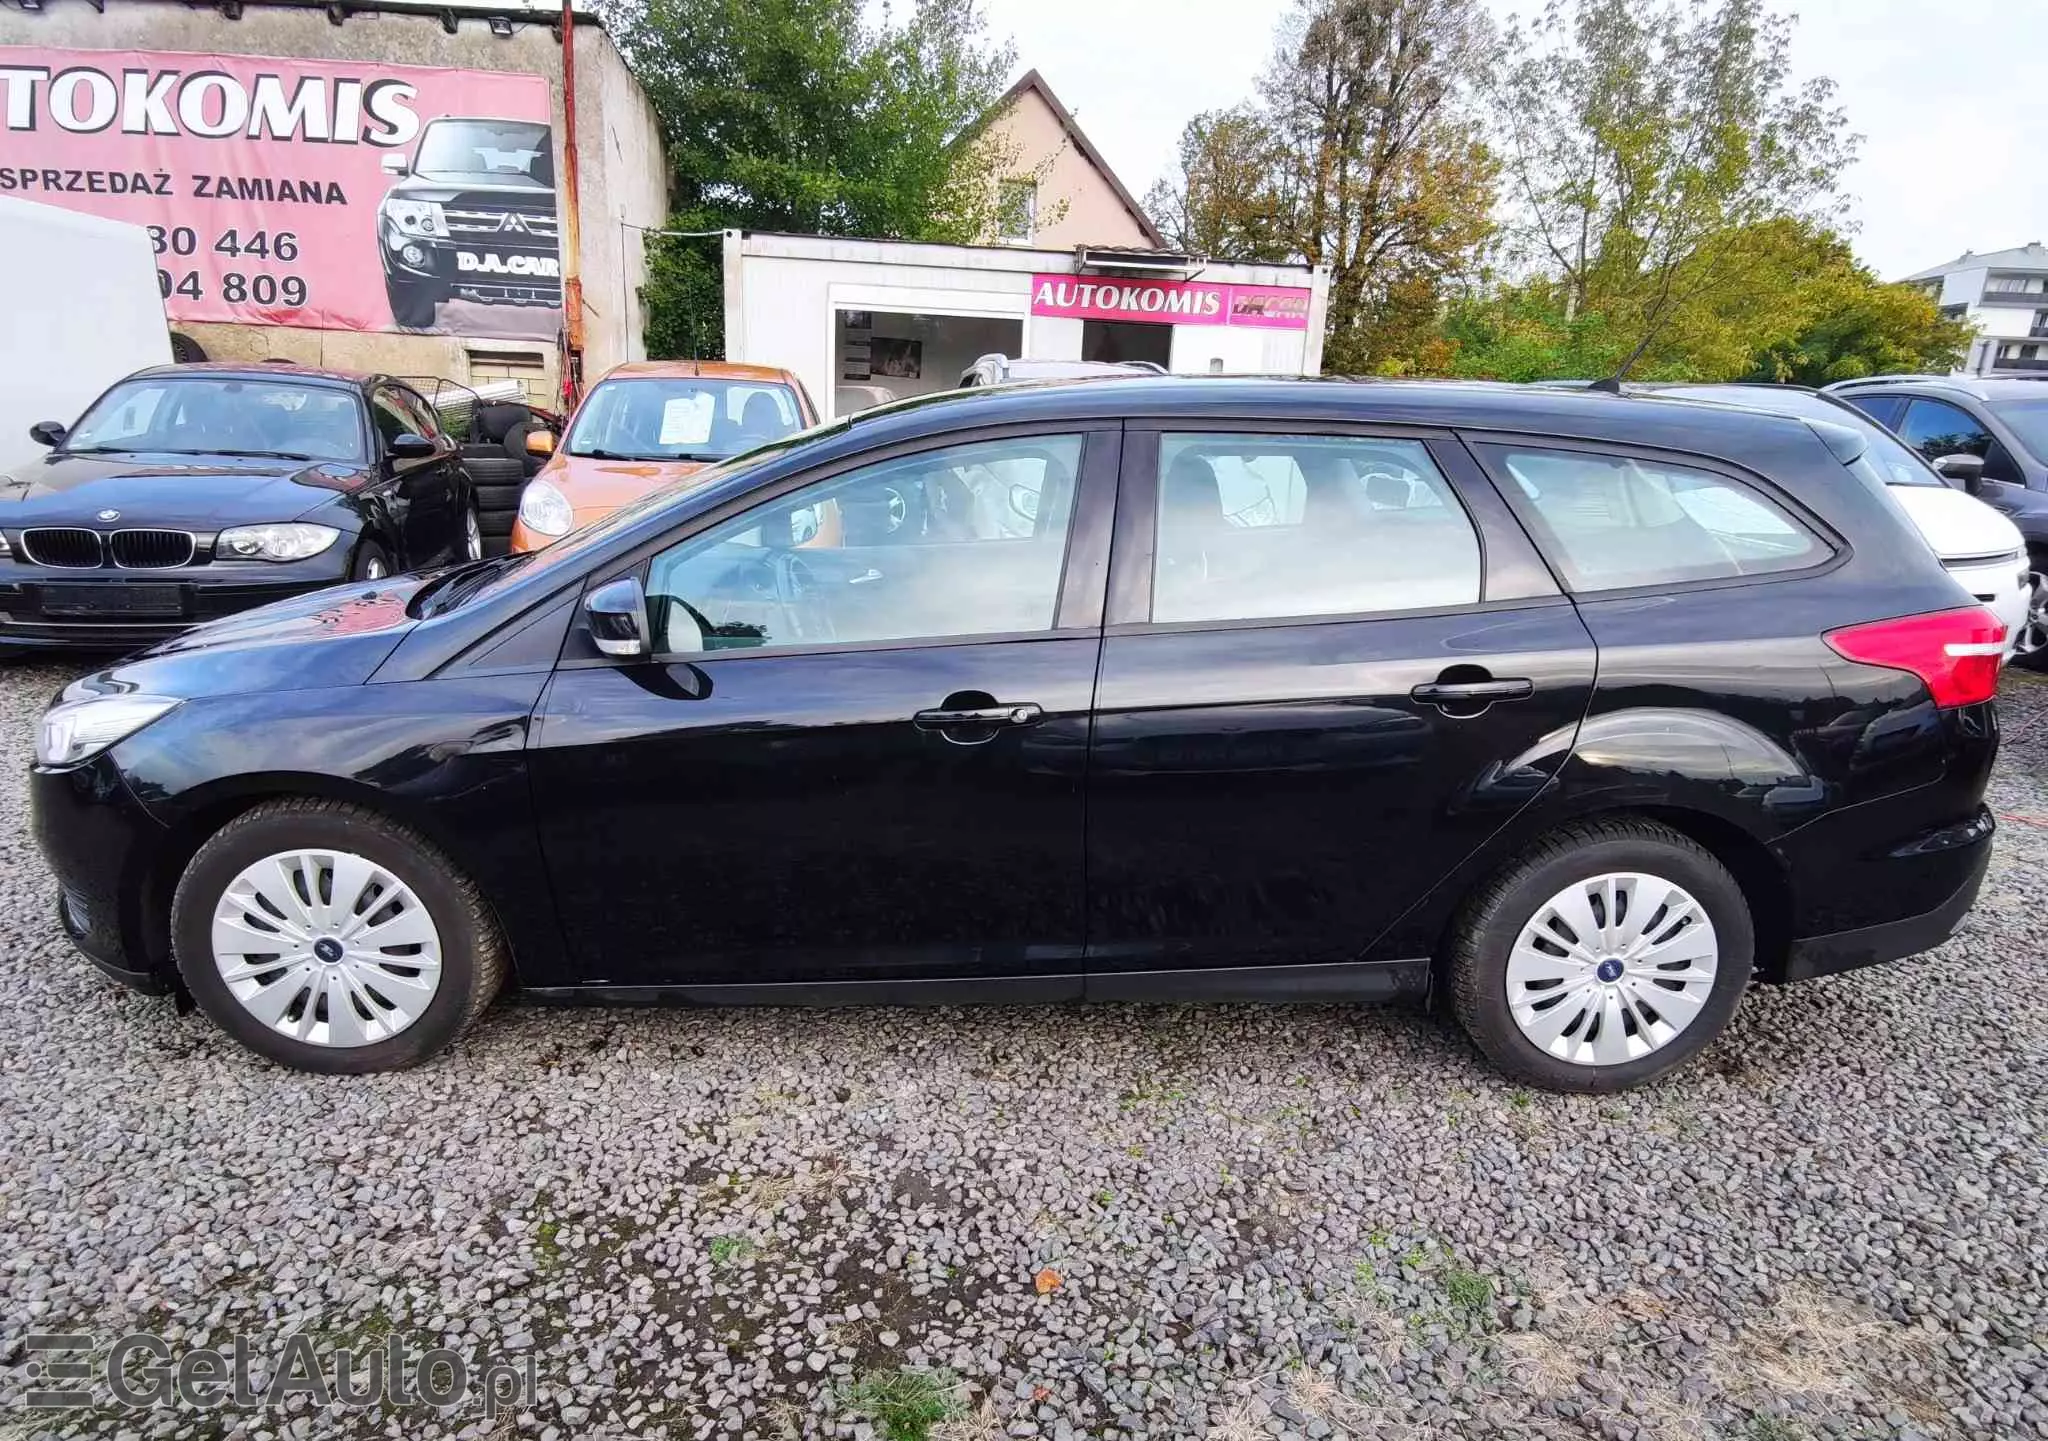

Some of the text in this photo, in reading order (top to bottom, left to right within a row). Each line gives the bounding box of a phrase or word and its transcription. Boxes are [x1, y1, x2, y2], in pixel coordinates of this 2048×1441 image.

[0, 64, 420, 148] TOKOMIS
[0, 167, 348, 206] SPRZEDAŻ ZAMIANA
[214, 229, 298, 262] 446
[222, 272, 307, 307] 809
[1033, 280, 1221, 316] AUTOKOMIS
